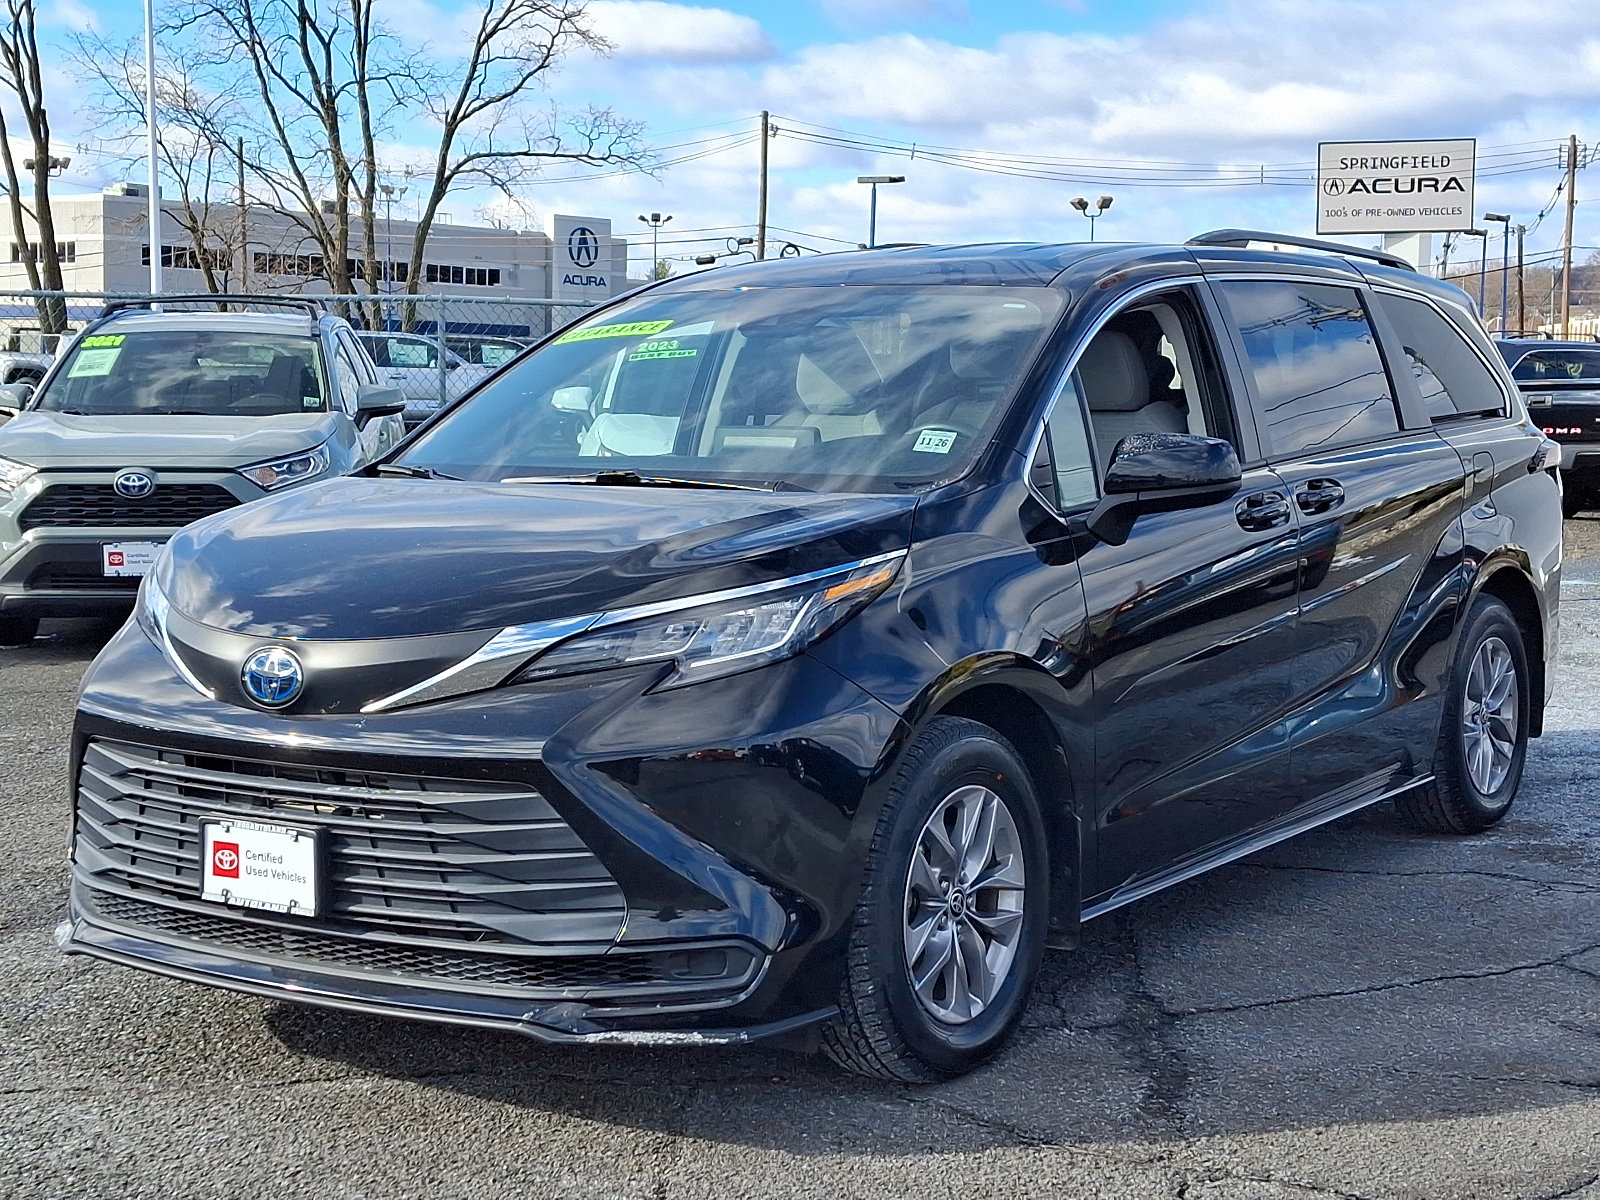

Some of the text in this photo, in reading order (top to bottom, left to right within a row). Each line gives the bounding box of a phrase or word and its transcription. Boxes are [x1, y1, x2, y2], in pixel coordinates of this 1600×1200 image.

[1340, 156, 1450, 170] SPRINGFIELD
[1347, 176, 1465, 195] ACURA
[1325, 206, 1462, 217] 100's OF PRE-OWNED VEHICLES
[563, 274, 606, 287] ACURA
[637, 340, 680, 352] 2023
[630, 349, 696, 360] BEST BUY
[920, 437, 949, 448] 11 26
[245, 849, 283, 864] Certified
[246, 865, 307, 884] Used Vehicles
